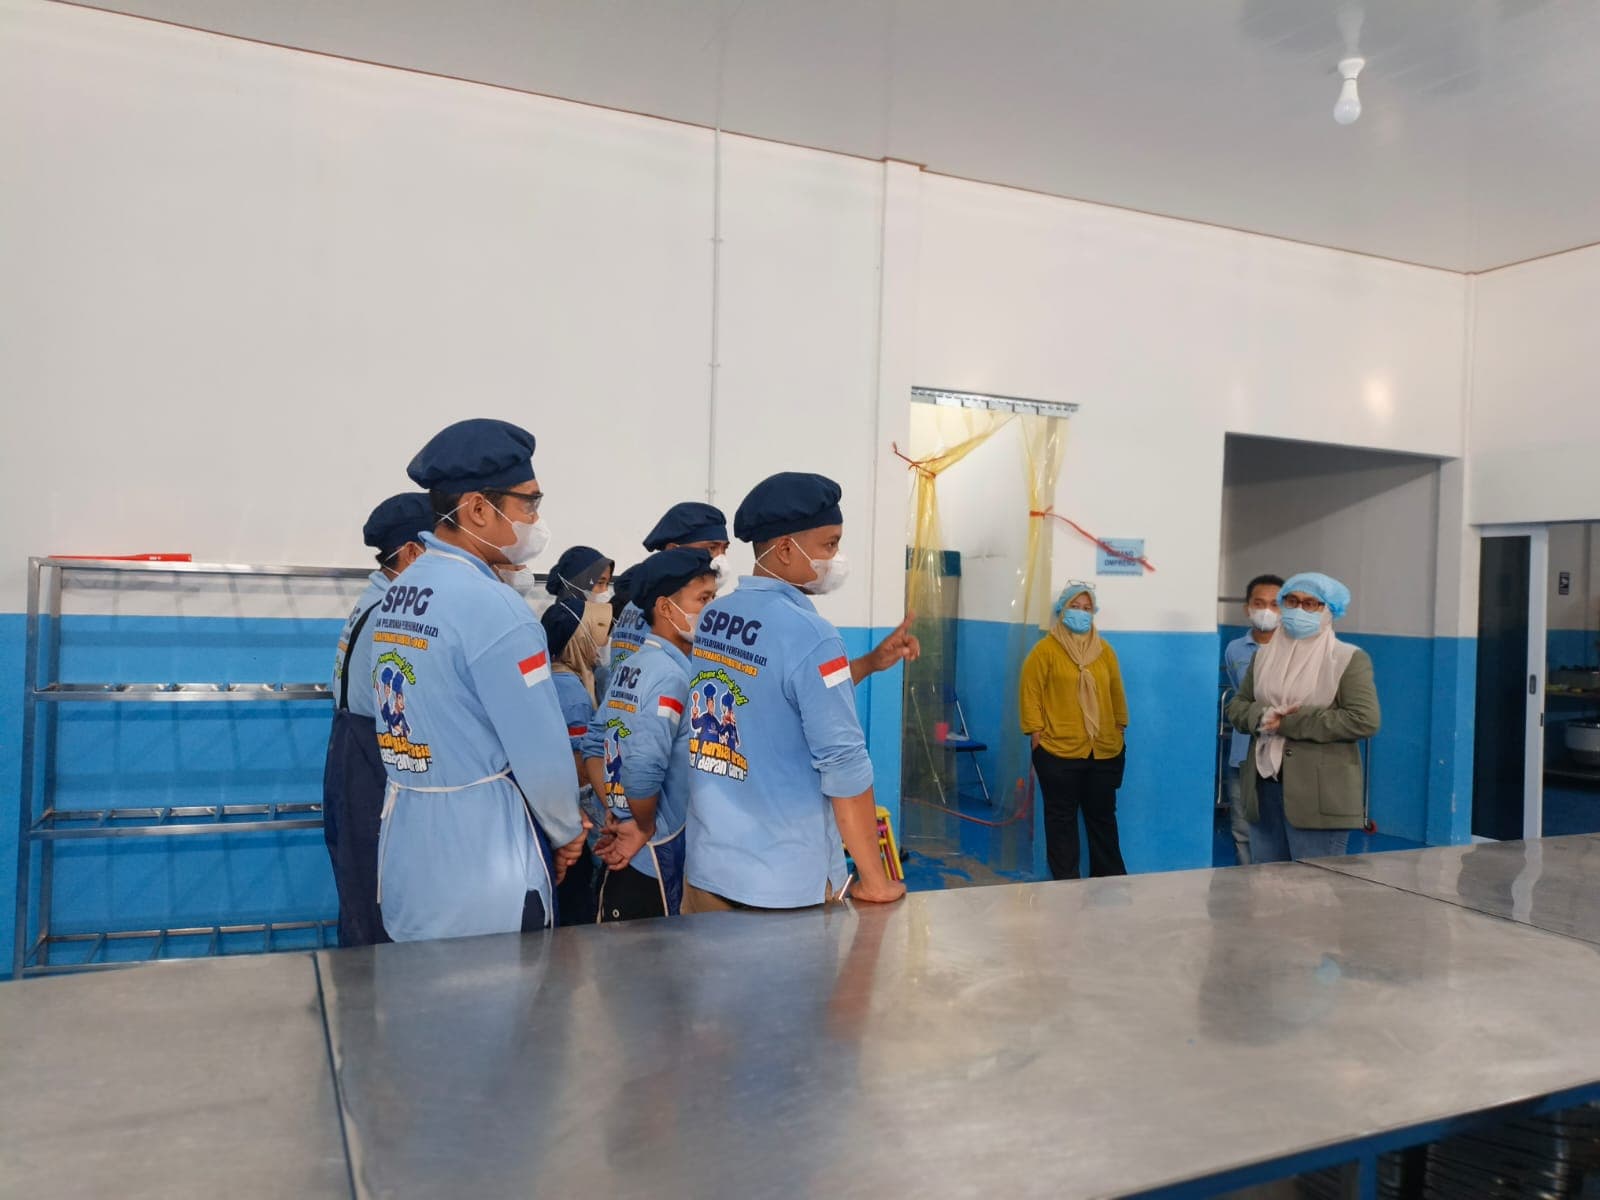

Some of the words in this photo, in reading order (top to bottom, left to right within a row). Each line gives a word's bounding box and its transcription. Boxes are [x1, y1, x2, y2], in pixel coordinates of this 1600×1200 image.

[381, 585, 434, 616] SPPG
[699, 608, 762, 646] SPPG
[753, 653, 768, 667] GIZI
